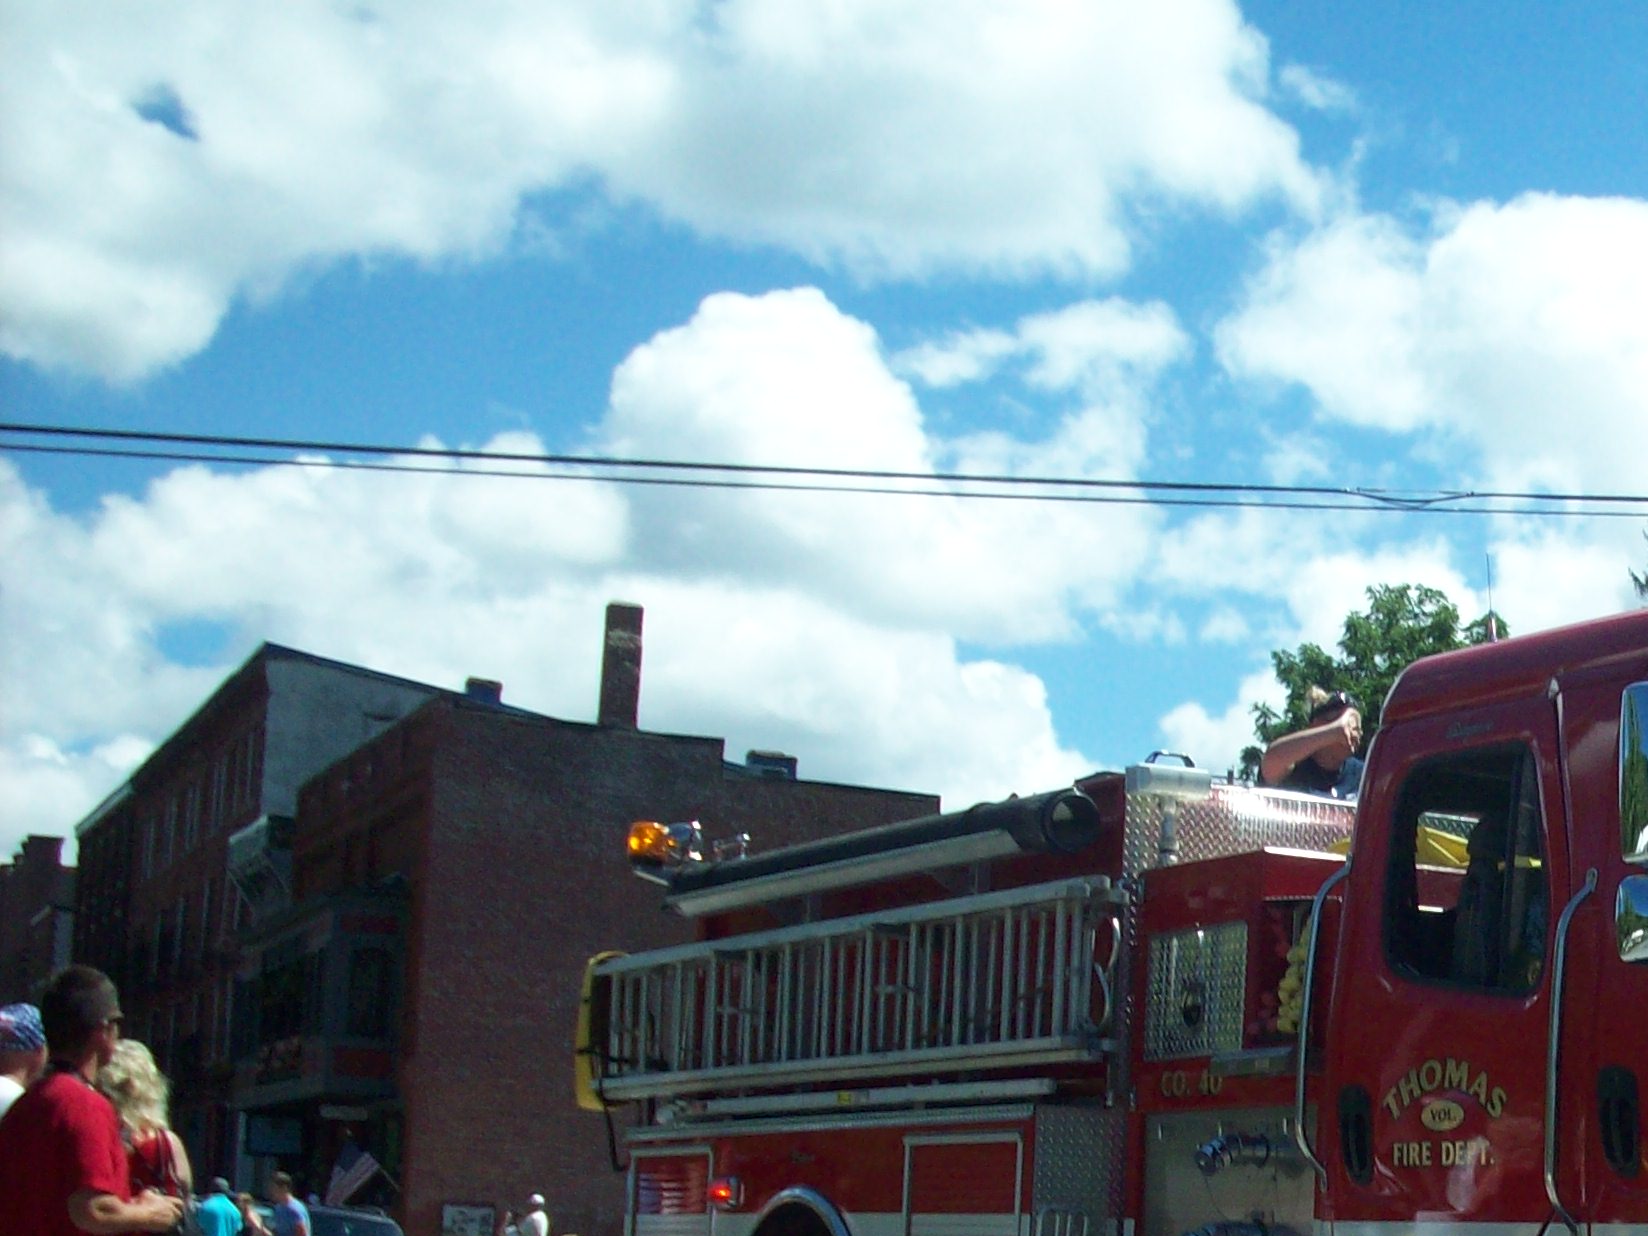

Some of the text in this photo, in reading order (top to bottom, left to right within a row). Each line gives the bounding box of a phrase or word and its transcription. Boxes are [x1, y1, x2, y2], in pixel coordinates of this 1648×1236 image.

[1161, 1069, 1190, 1097] CO.
[1383, 1057, 1508, 1120] THOMAS
[1429, 1108, 1457, 1123] VOL.
[1392, 1139, 1496, 1167] FIRE DEPT.
